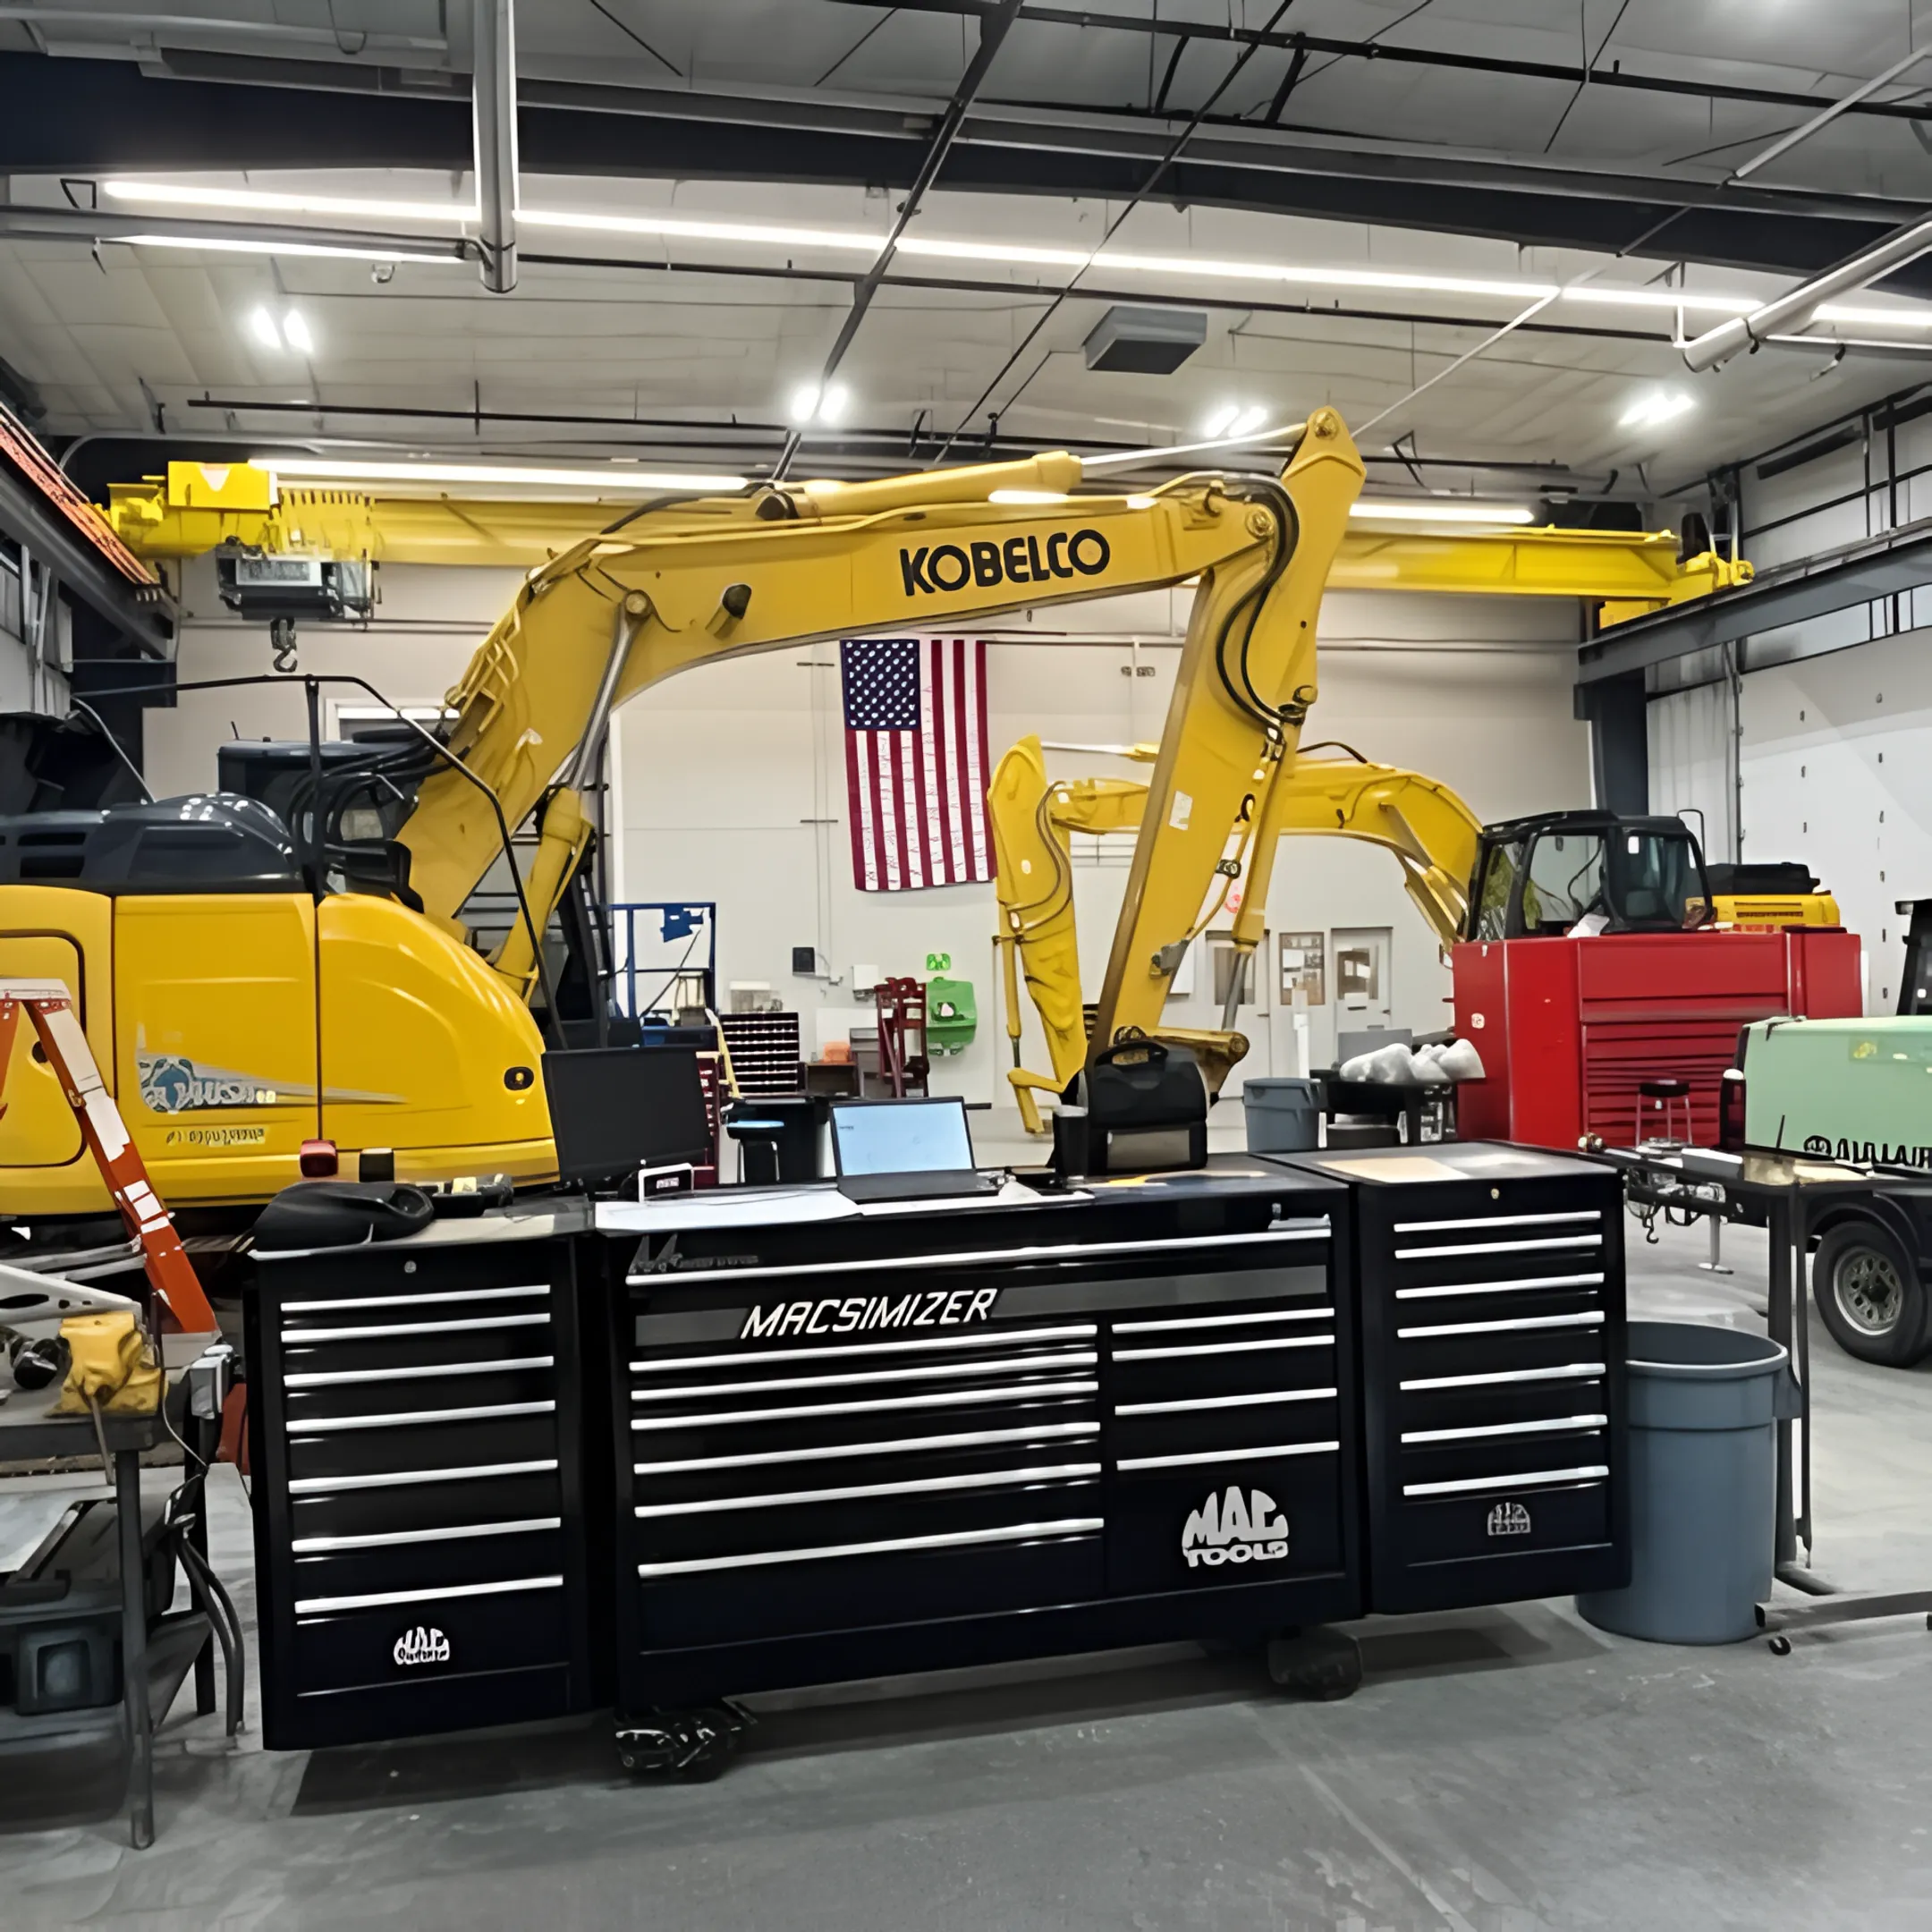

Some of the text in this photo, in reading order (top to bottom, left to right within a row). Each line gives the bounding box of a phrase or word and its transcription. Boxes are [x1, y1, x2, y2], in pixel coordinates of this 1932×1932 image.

[900, 529, 1110, 597] KOBELCO
[740, 1288, 998, 1340] MACSIMIZER
[1182, 1486, 1289, 1549] MAC
[1182, 1541, 1288, 1567] TOOLS
